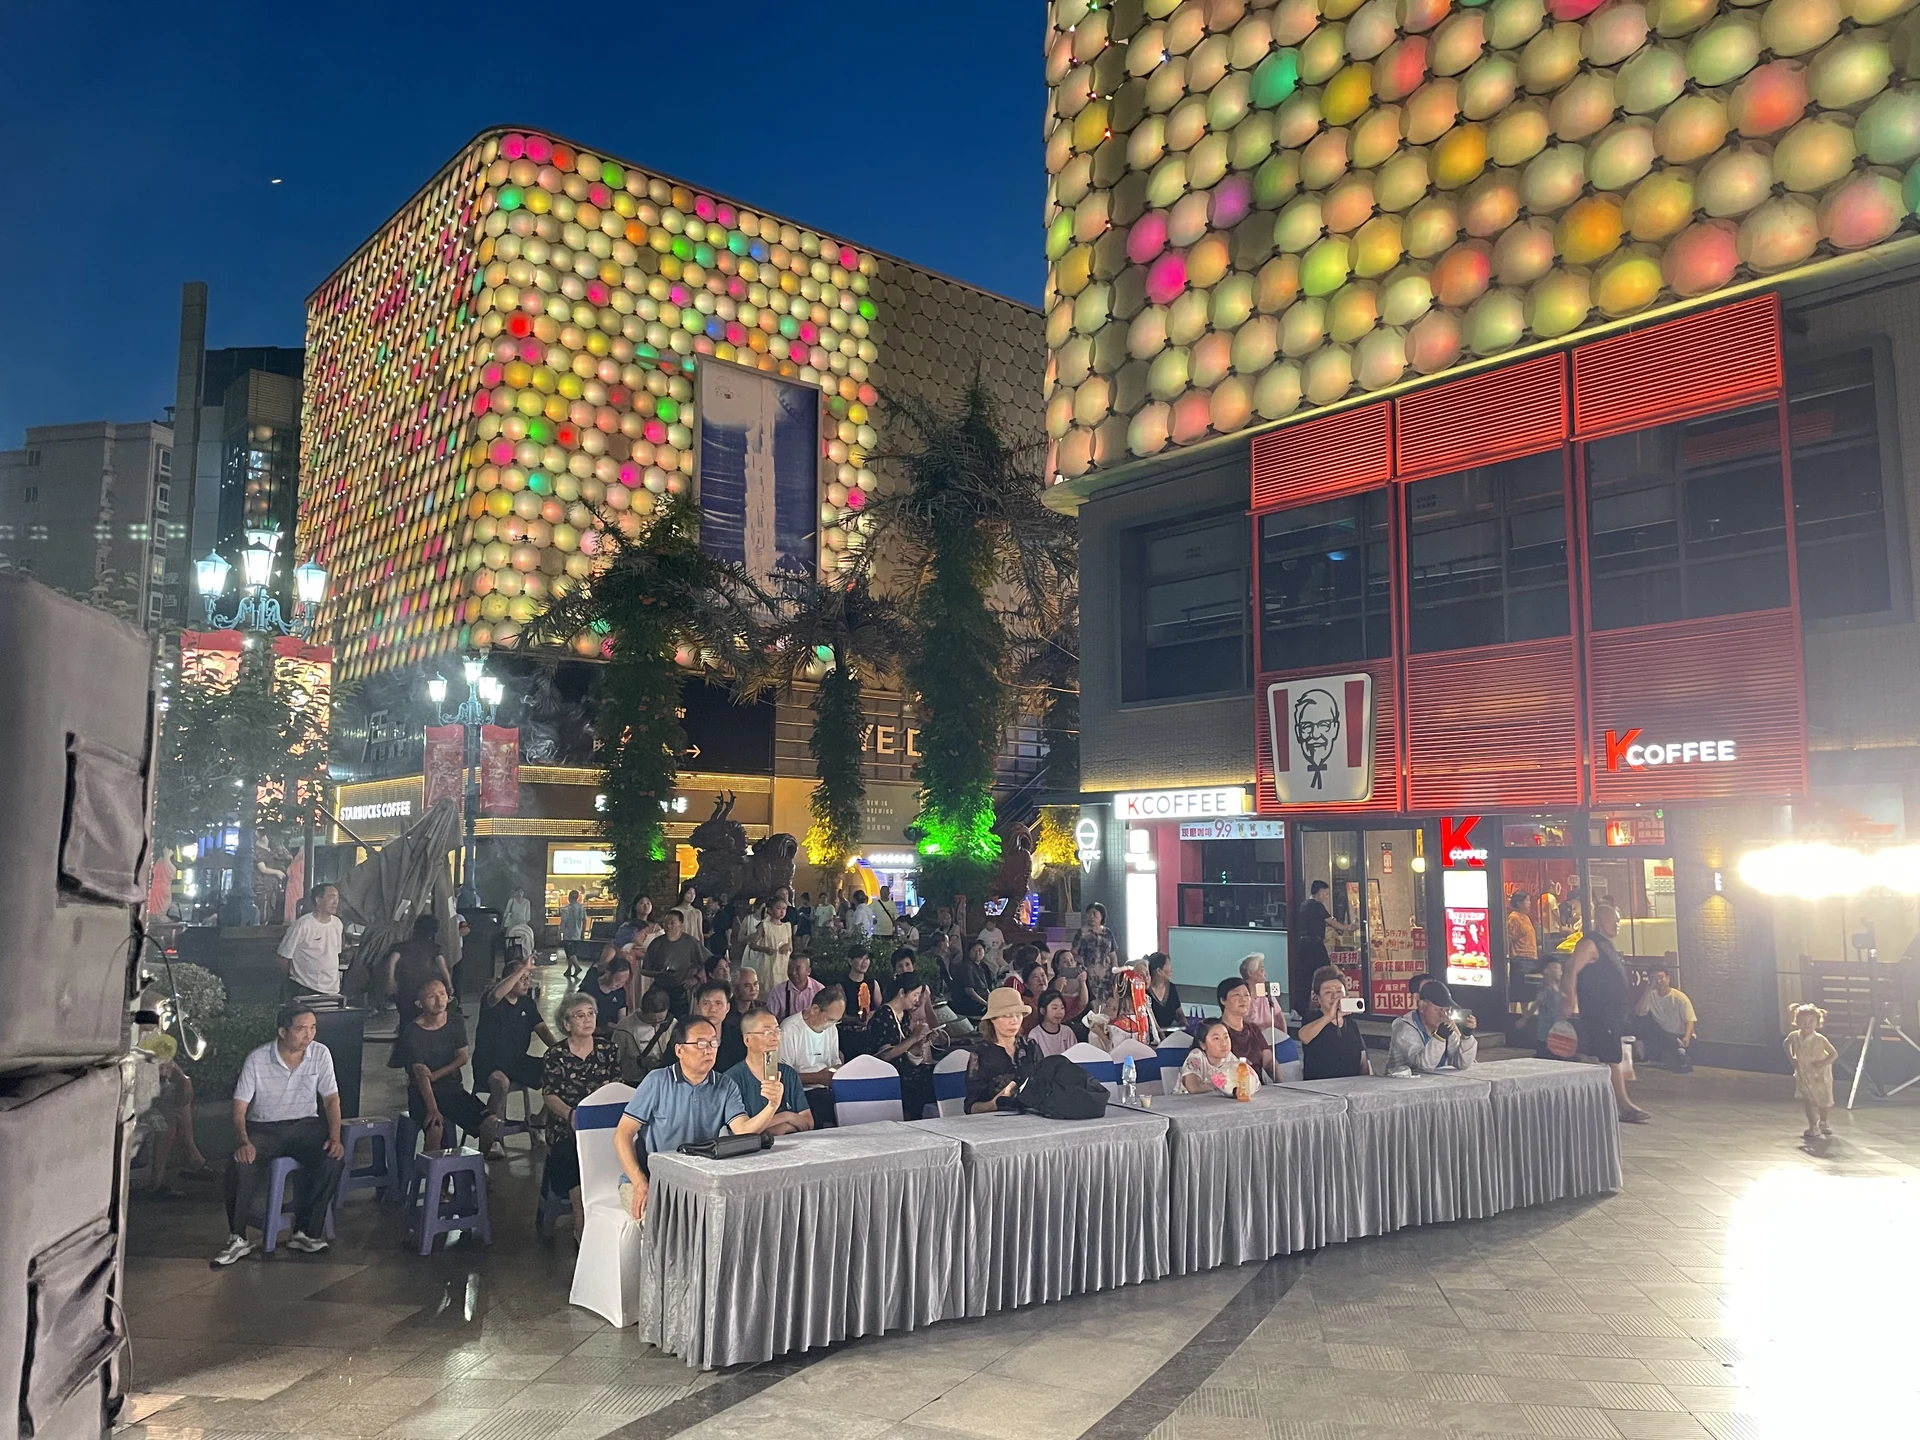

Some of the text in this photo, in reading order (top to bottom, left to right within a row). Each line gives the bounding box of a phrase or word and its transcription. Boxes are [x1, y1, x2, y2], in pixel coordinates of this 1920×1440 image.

[340, 801, 411, 820] STARBUCKS COFFEE
[1374, 961, 1425, 972] 疯狂星期四
